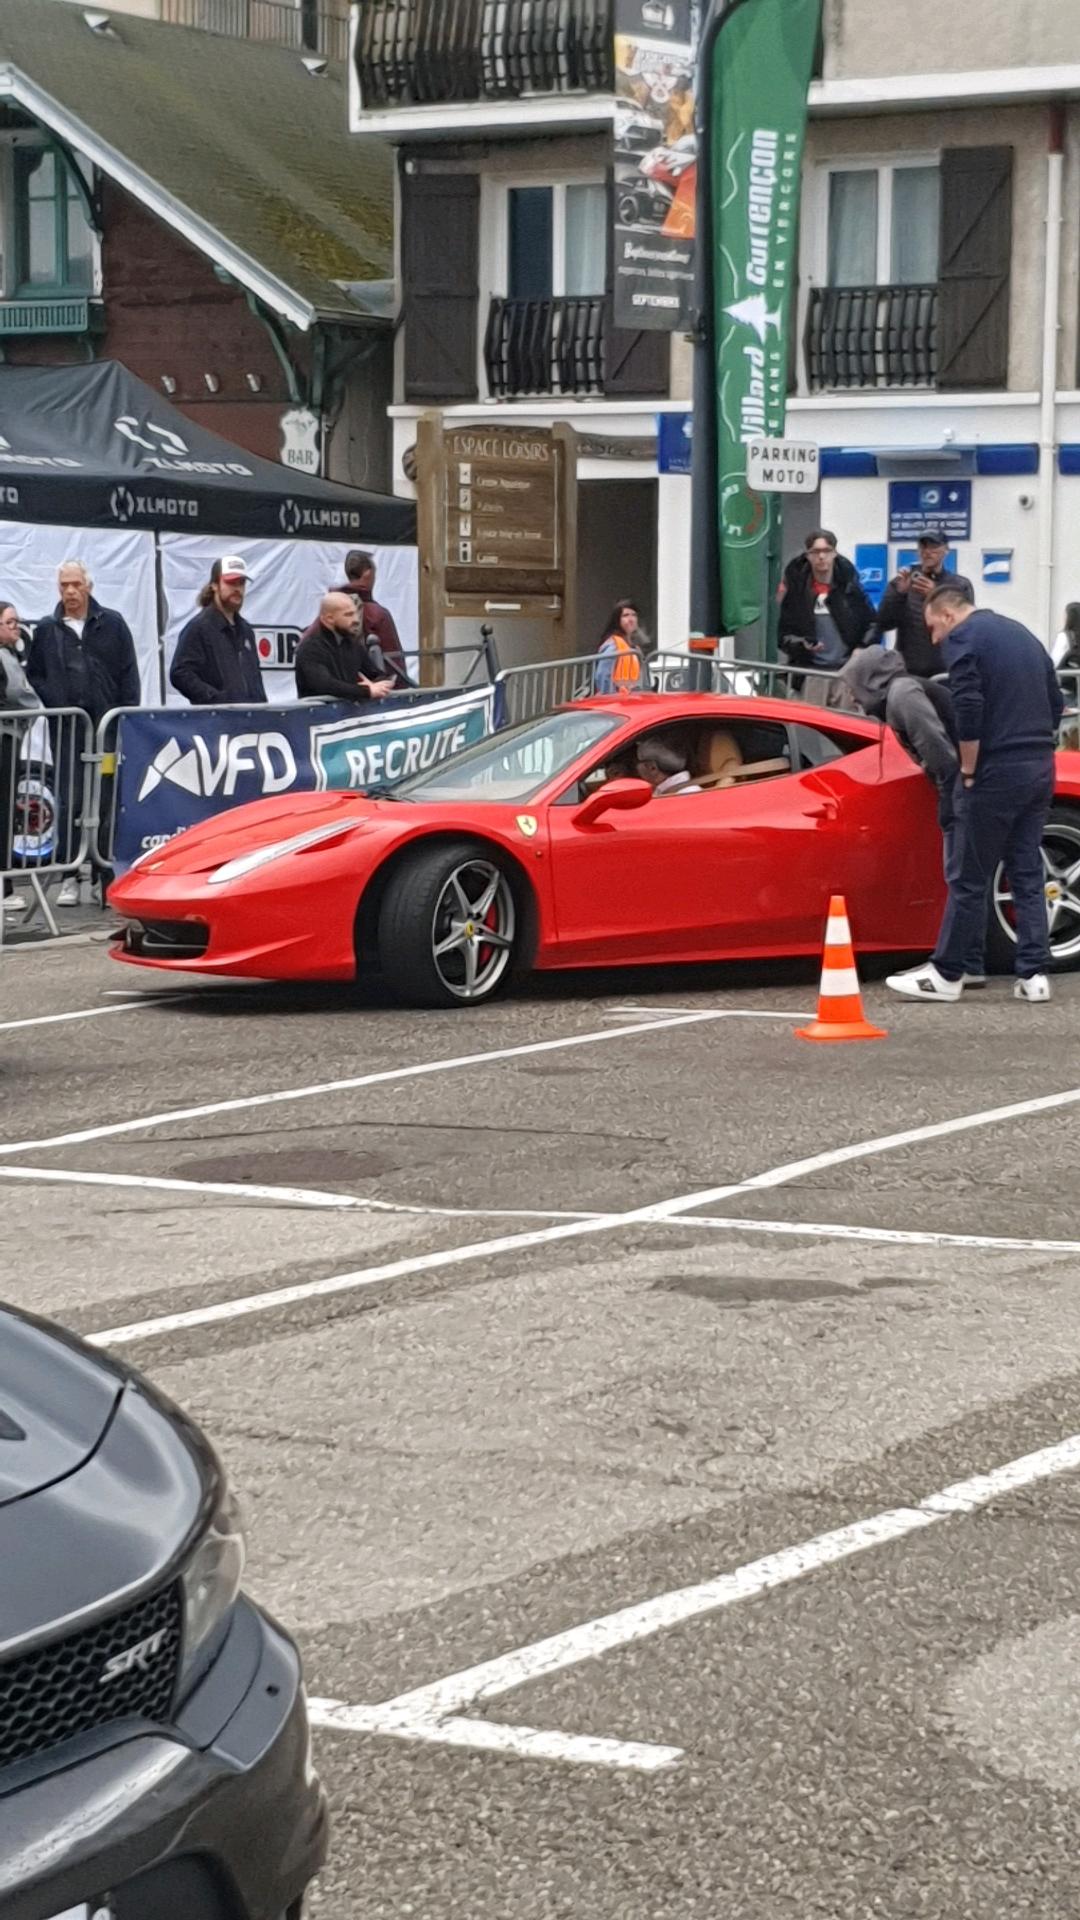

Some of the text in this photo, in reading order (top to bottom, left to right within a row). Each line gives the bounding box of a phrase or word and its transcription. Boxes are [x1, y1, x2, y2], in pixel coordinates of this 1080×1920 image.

[772, 260, 786, 288] EN
[769, 352, 781, 407] LANS
[740, 345, 766, 443] Villard
[287, 449, 314, 465] BAR
[453, 436, 549, 461] ESPACE LOISIRS
[751, 446, 816, 462] PARKING
[142, 457, 254, 476] XLMOTO
[762, 469, 804, 484] MOTO
[136, 496, 198, 516] XLMOTO
[302, 509, 360, 528] XLMOTO
[193, 732, 297, 797] VFD
[345, 722, 466, 788] RECRUTE
[99, 1627, 167, 1683] SRT
